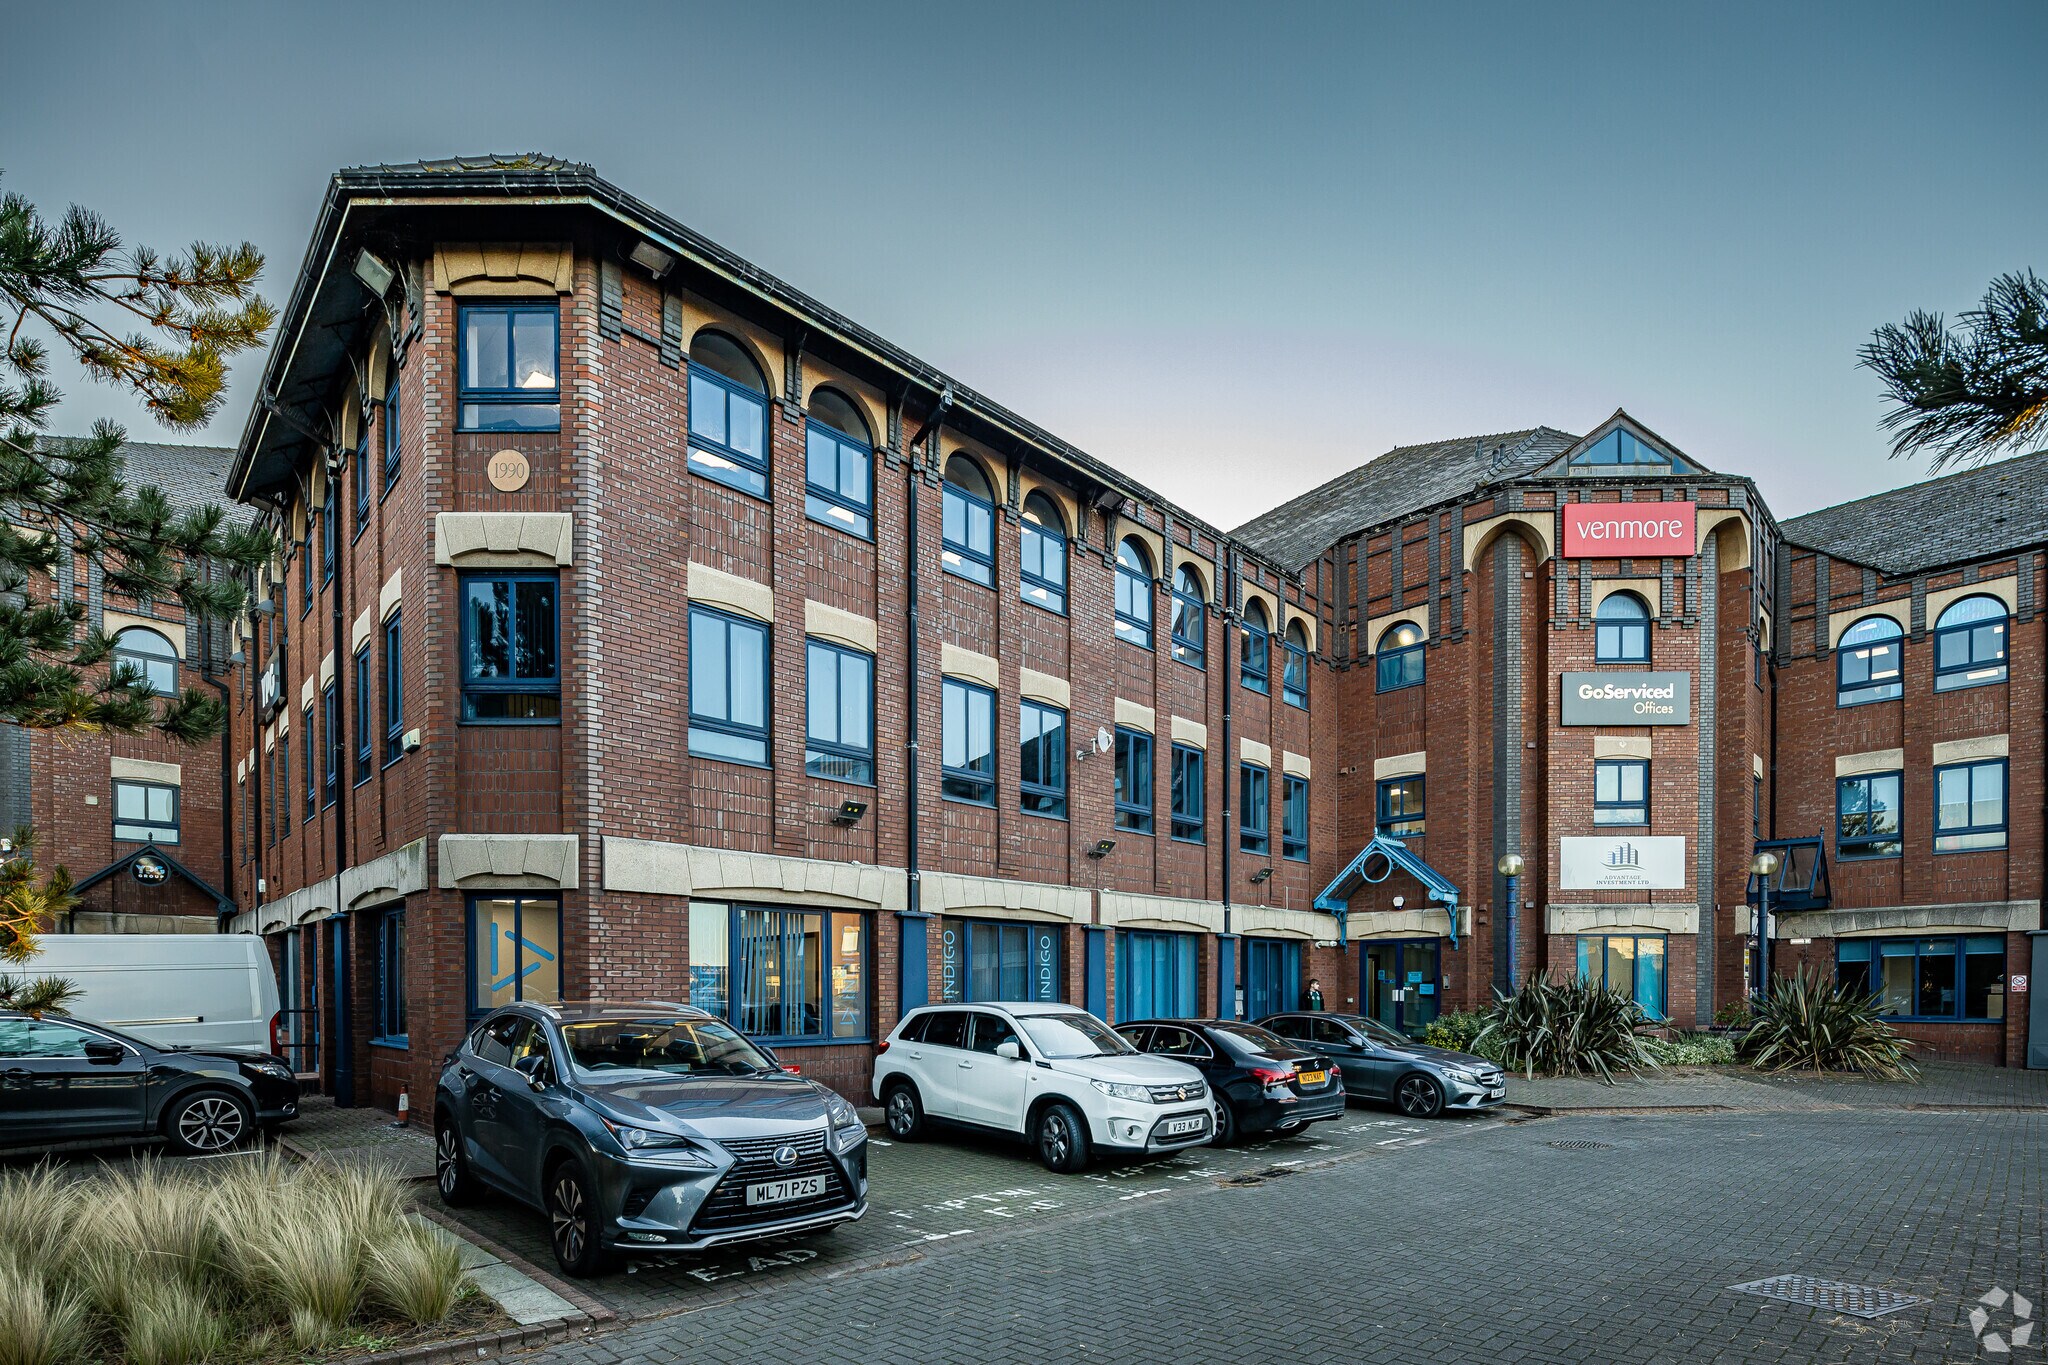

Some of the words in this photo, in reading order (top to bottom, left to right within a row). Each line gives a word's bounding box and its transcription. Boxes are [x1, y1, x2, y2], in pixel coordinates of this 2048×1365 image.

[494, 462, 525, 479] 1990
[1576, 519, 1683, 540] venmore
[1578, 683, 1674, 700] GoServiced
[1633, 701, 1674, 715] Offices
[943, 930, 955, 999] INDIGO
[1040, 935, 1051, 998] INDIGO
[756, 1183, 788, 1202] ML71
[791, 1179, 818, 1196] PZS
